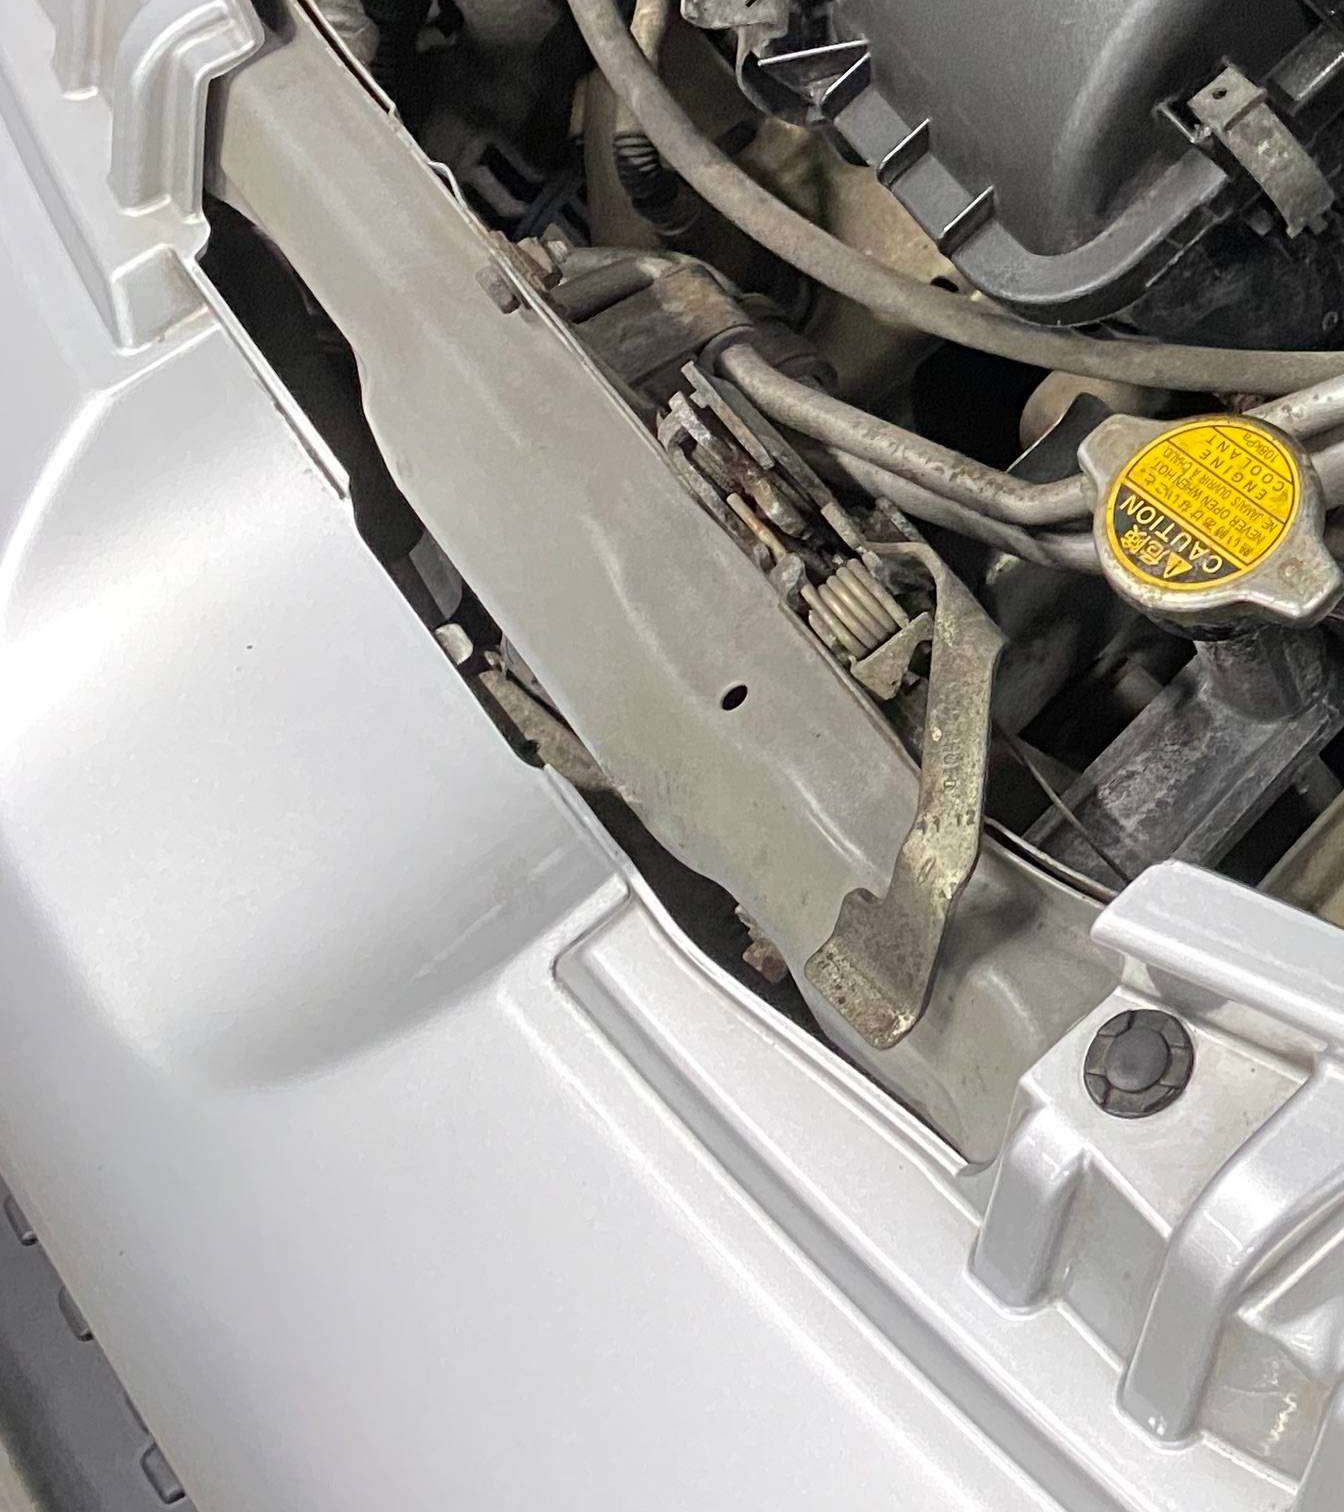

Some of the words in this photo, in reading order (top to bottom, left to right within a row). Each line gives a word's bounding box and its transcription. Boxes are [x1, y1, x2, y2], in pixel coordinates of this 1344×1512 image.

[1199, 448, 1268, 501] ENGINE
[1206, 434, 1286, 492] COOLANT
[1201, 493, 1231, 520] OPEN
[1119, 494, 1223, 573] CAUTION
[1120, 524, 1171, 566] 危険
[1229, 520, 1266, 544] NEVER
